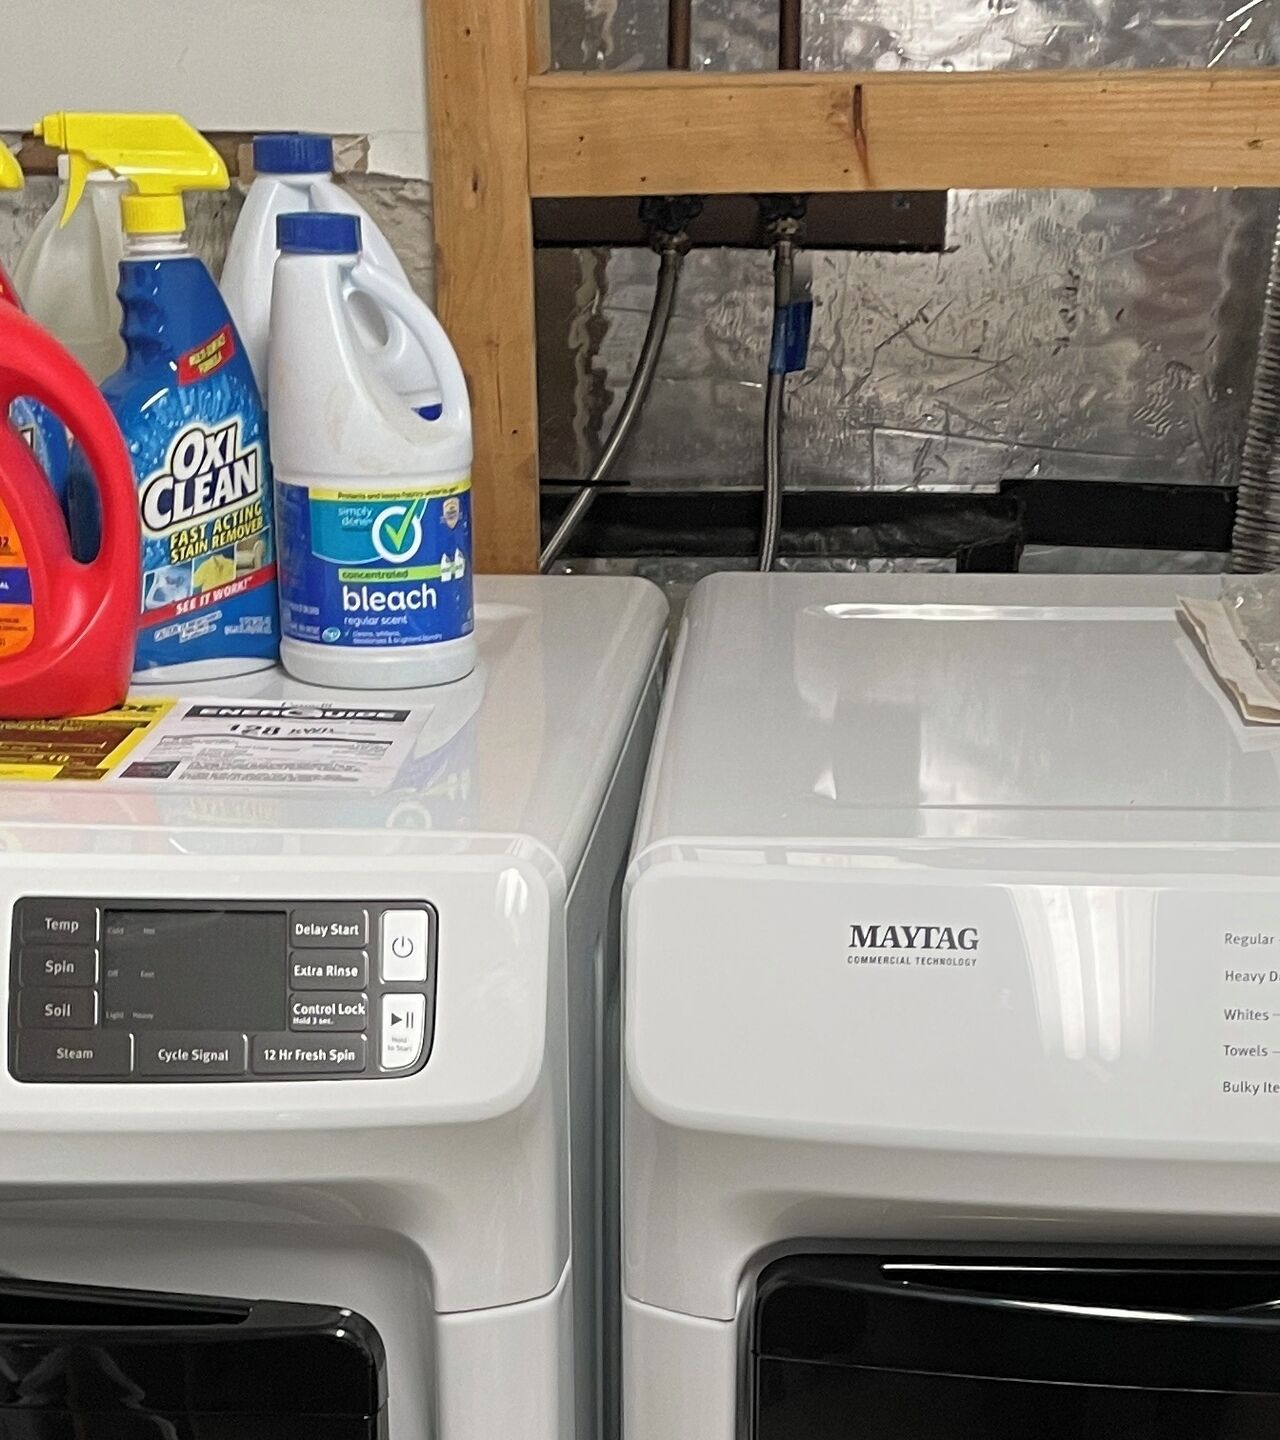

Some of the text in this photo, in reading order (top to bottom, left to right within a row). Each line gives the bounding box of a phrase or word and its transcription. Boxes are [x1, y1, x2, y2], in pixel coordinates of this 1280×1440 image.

[171, 422, 238, 481] OXI
[142, 448, 258, 530] CLEAN
[338, 506, 373, 519] simply
[170, 501, 262, 550] FAST ACTING
[172, 516, 263, 564] STAIN REMOVER
[342, 569, 409, 580] concentrated
[176, 600, 196, 615] SEE
[200, 593, 210, 605] IT
[342, 583, 437, 612] bleach
[344, 614, 408, 627] regular scent
[44, 917, 79, 933] Temp
[295, 923, 359, 937] Delay Start
[848, 924, 980, 951] MAYTAG
[1224, 933, 1275, 948] Regular
[45, 960, 74, 975] Spin
[847, 956, 977, 967] COMMERCIAL TECHNOLOGY
[294, 965, 358, 977] Extra Rinse
[1225, 971, 1265, 984] Heavy
[44, 1003, 71, 1017] Soil
[293, 1003, 366, 1015] Control Lock
[1224, 1009, 1269, 1021] Whites
[293, 1017, 310, 1025] Hold
[56, 1047, 94, 1060] Steam
[158, 1048, 229, 1063] Cycle Signal
[263, 1049, 356, 1063] 12 Hr Fresh Spin
[1223, 1045, 1268, 1057] Towels
[1222, 1081, 1260, 1096] Bulky
